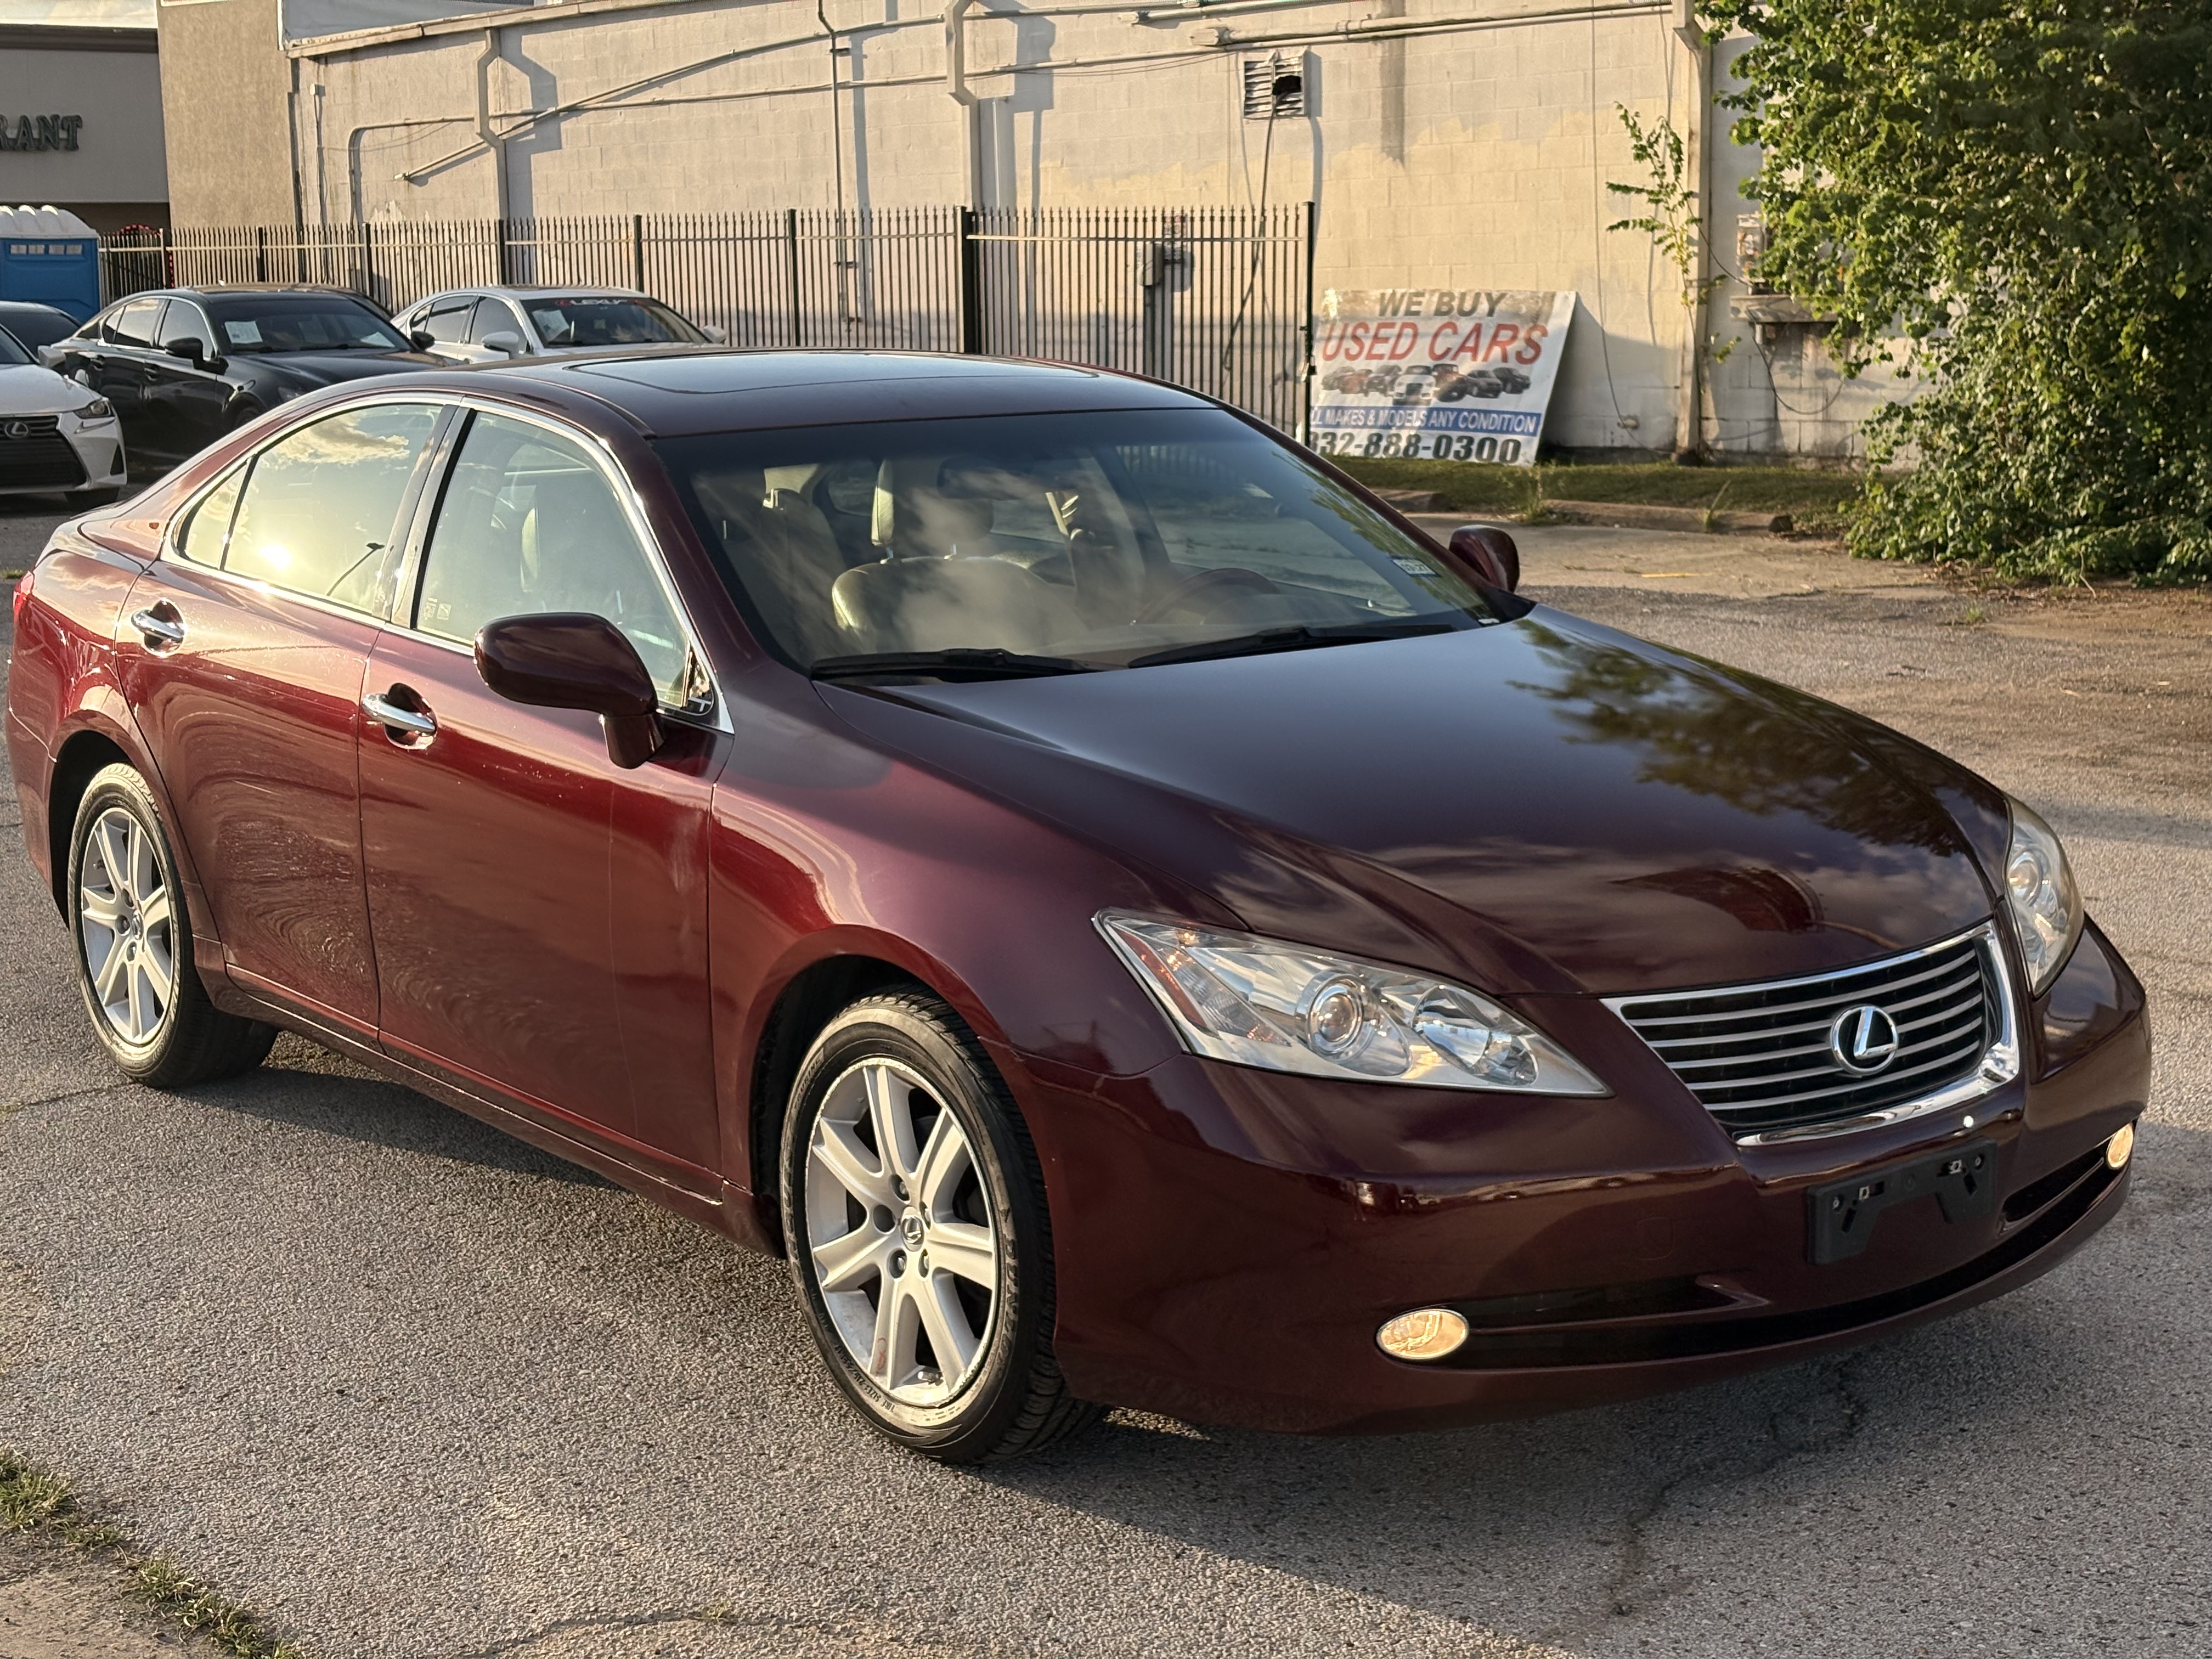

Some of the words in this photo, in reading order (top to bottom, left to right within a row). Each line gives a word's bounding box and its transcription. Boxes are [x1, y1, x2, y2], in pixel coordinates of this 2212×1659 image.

[1379, 290, 1425, 317] WE
[1434, 292, 1507, 317] BUY
[1323, 321, 1420, 362] USED
[1428, 321, 1549, 365] CARS
[1311, 409, 1323, 425] LL
[1325, 410, 1365, 426] MAKES
[1367, 410, 1376, 426] &
[1378, 410, 1427, 427] MODELS
[1427, 410, 1458, 428] ANY
[1458, 411, 1536, 433] CONDITION
[996, 1234, 1018, 1379] DUNLOP
